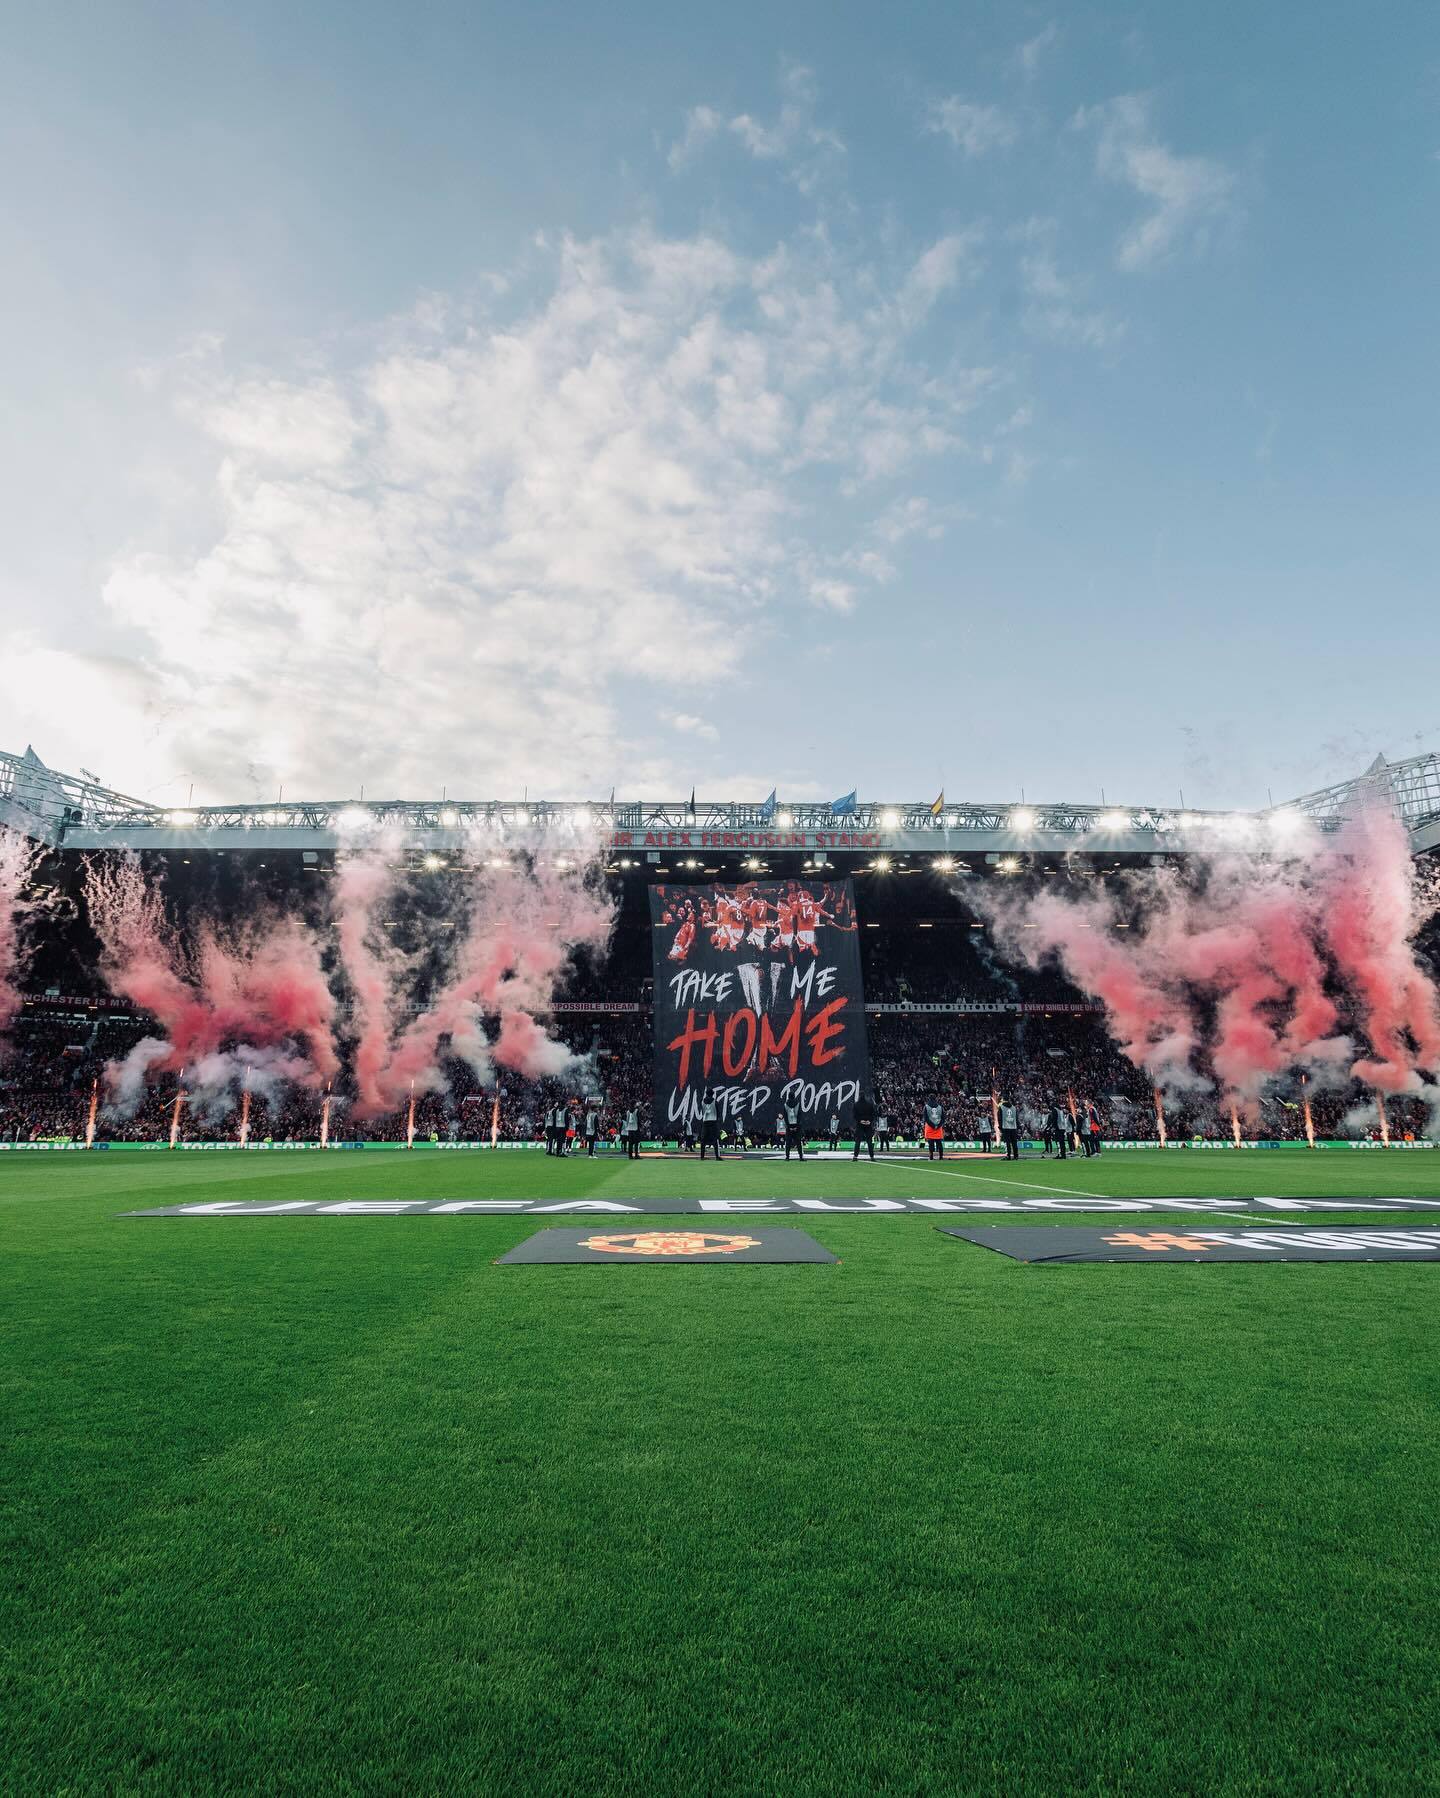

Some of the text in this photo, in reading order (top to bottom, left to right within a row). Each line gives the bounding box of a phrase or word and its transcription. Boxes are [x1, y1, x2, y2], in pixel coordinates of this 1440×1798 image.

[643, 832, 692, 847] ALEX
[702, 832, 805, 847] FERGUSON
[816, 832, 881, 847] STAND
[669, 959, 838, 1010] TAKE ME
[110, 999, 128, 1007] MY
[603, 1003, 635, 1011] DREAM
[666, 995, 849, 1091] HOME
[178, 1200, 644, 1213] UEFA
[699, 1197, 1410, 1211] EUROPA
